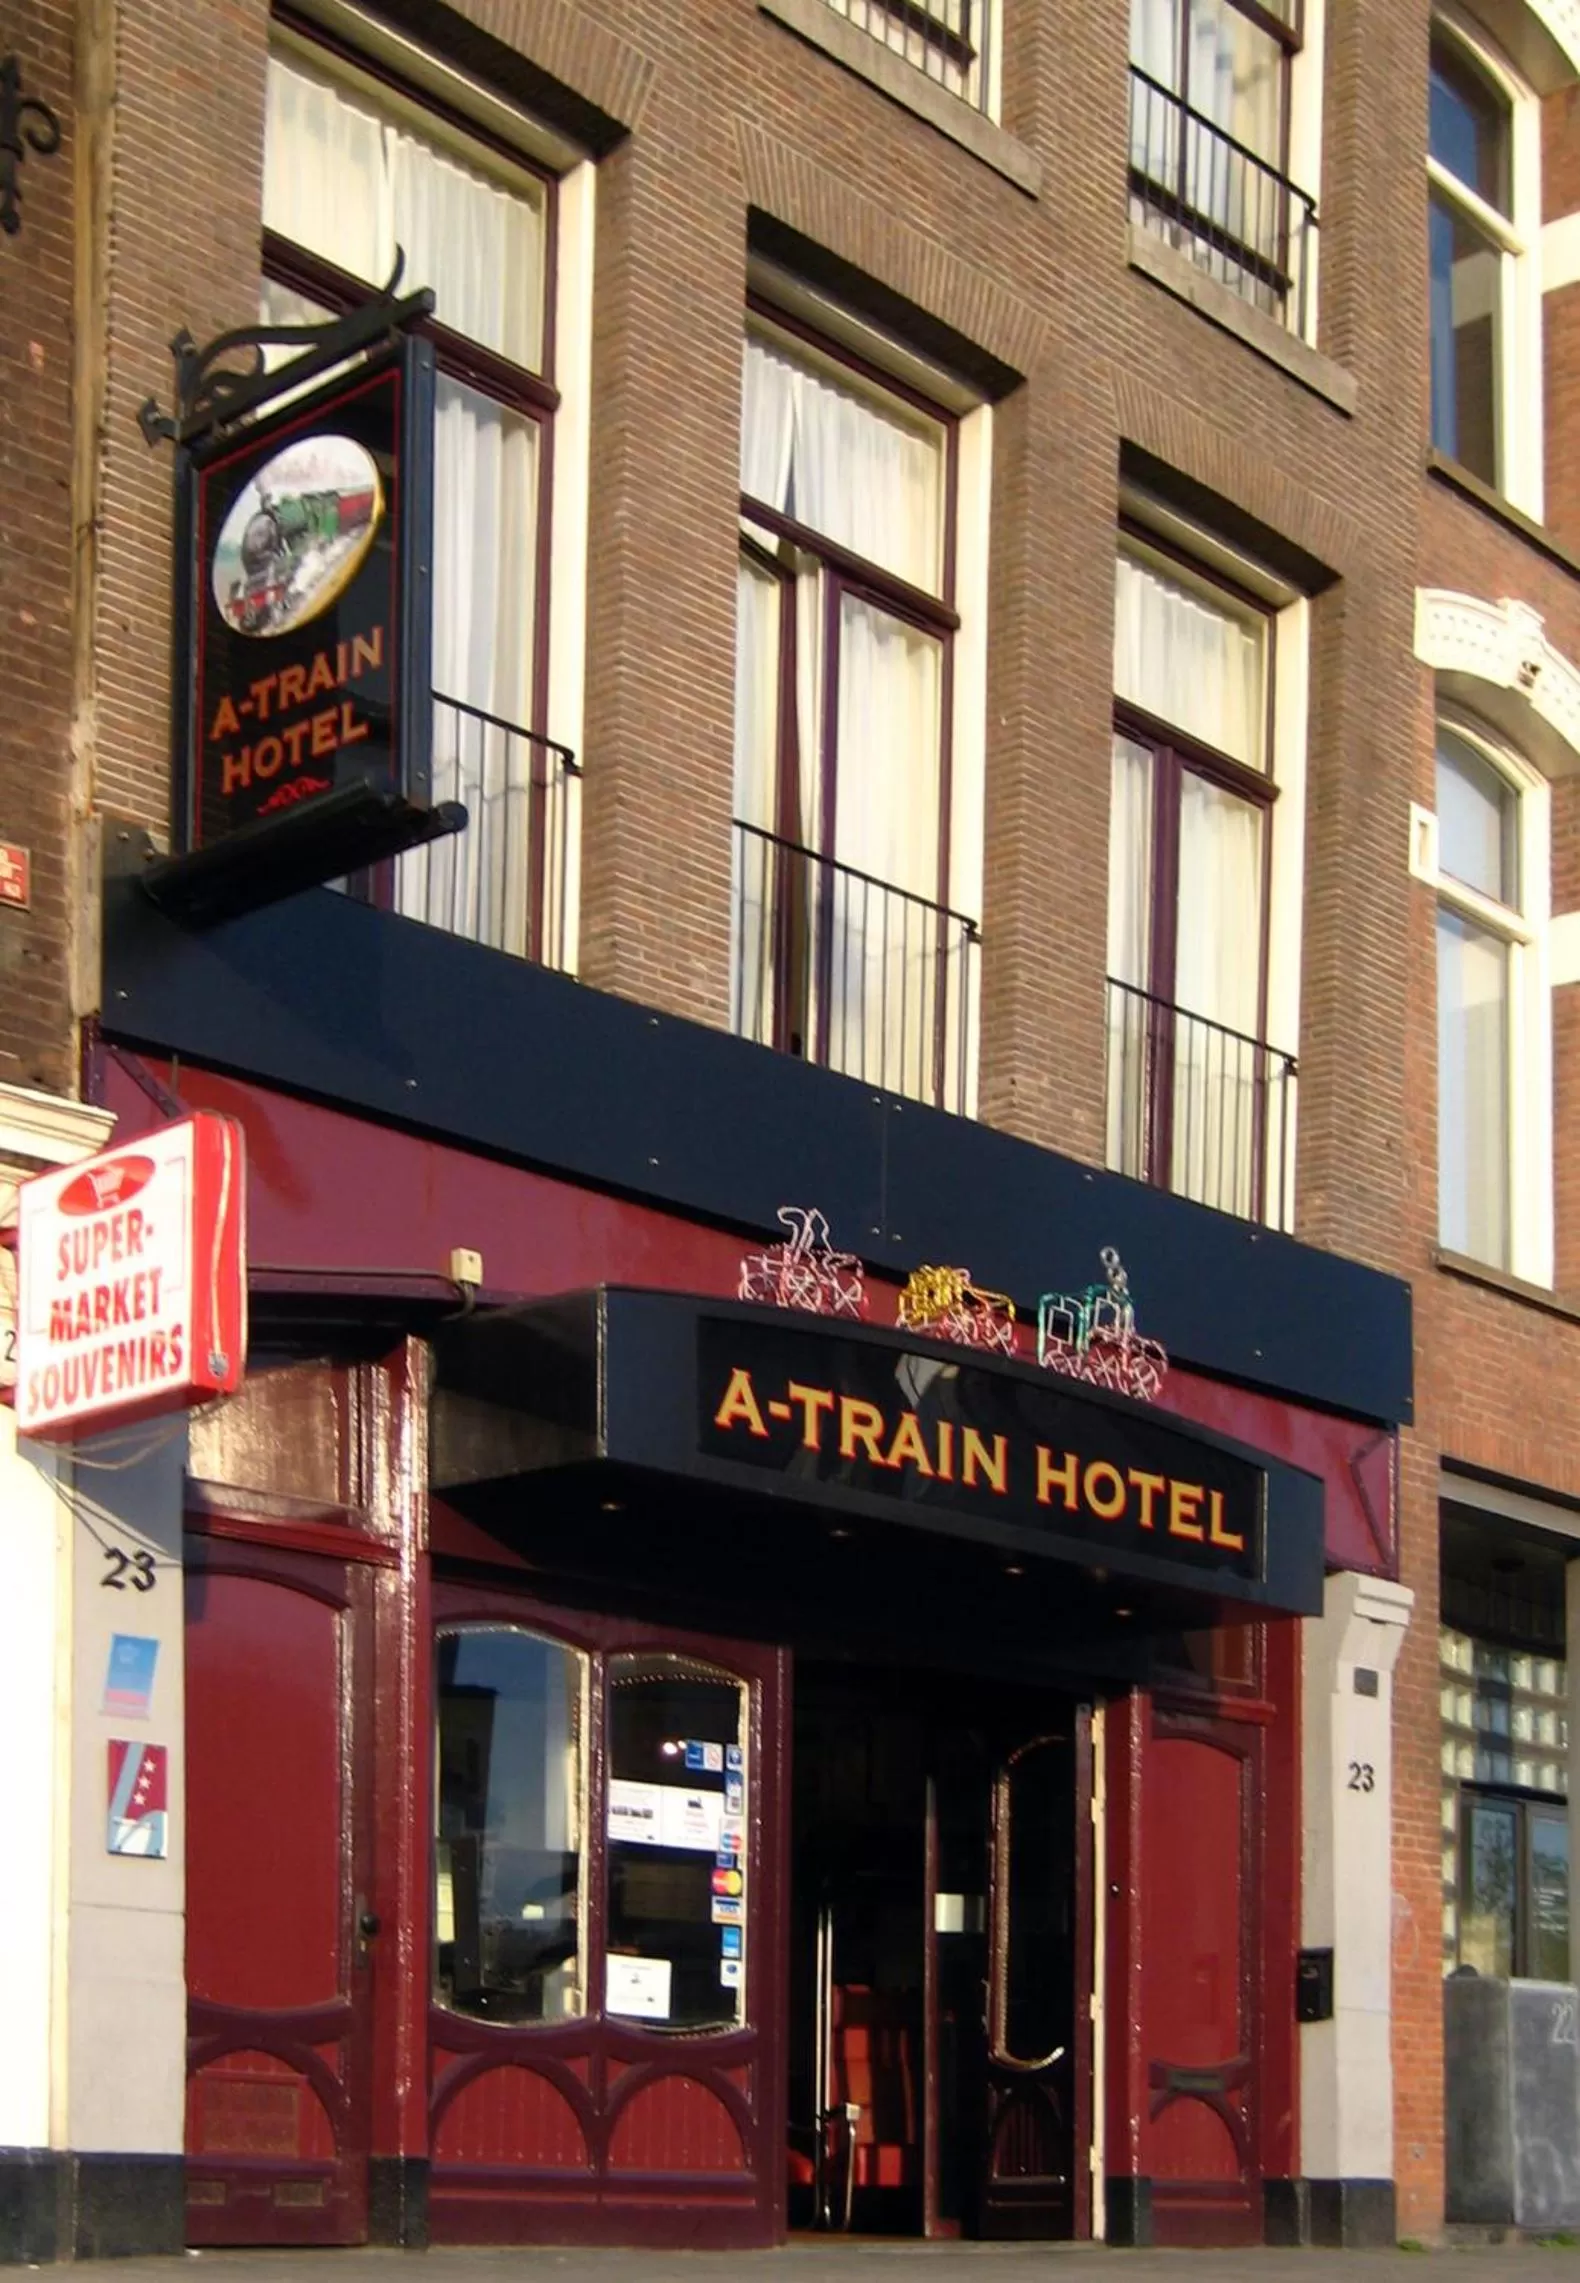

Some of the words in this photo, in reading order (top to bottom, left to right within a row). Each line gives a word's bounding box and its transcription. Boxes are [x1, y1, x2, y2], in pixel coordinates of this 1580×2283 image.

[209, 625, 384, 742] A-TRAIN
[220, 702, 369, 795] HOTEL
[57, 1208, 153, 1282] SUPER-
[49, 1267, 163, 1345] MARKET
[28, 1322, 183, 1417] SOUVENIRS
[714, 1367, 1009, 1495] A-TRAIN
[1036, 1444, 1245, 1553] HOTEL
[100, 1547, 157, 1592] 23
[1348, 1761, 1375, 1793] 23
